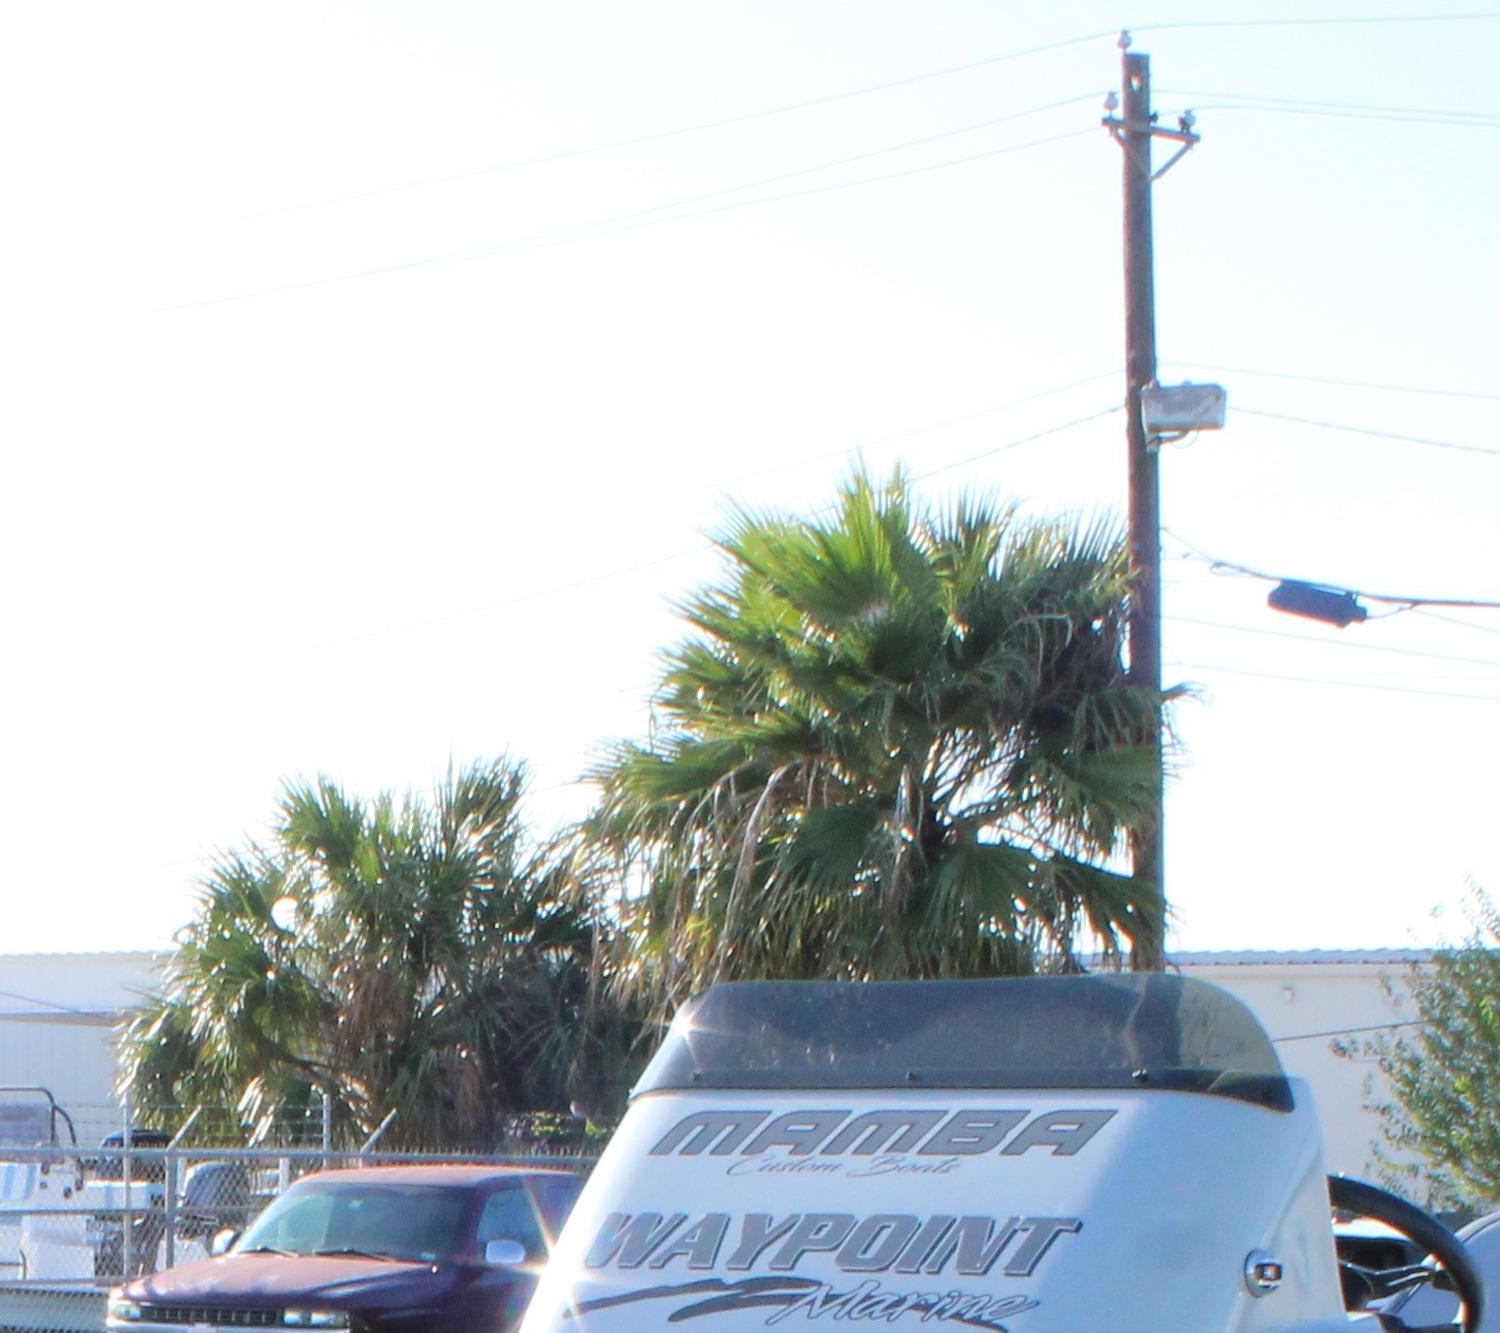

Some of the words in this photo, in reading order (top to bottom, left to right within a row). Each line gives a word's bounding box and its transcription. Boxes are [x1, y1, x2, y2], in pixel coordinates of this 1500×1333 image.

[647, 1109, 1120, 1157] MAMBA
[726, 1155, 842, 1178] Custom
[846, 1155, 961, 1178] Boats
[585, 1212, 1084, 1276] WAYPOINT
[764, 1281, 1040, 1327] Marine
